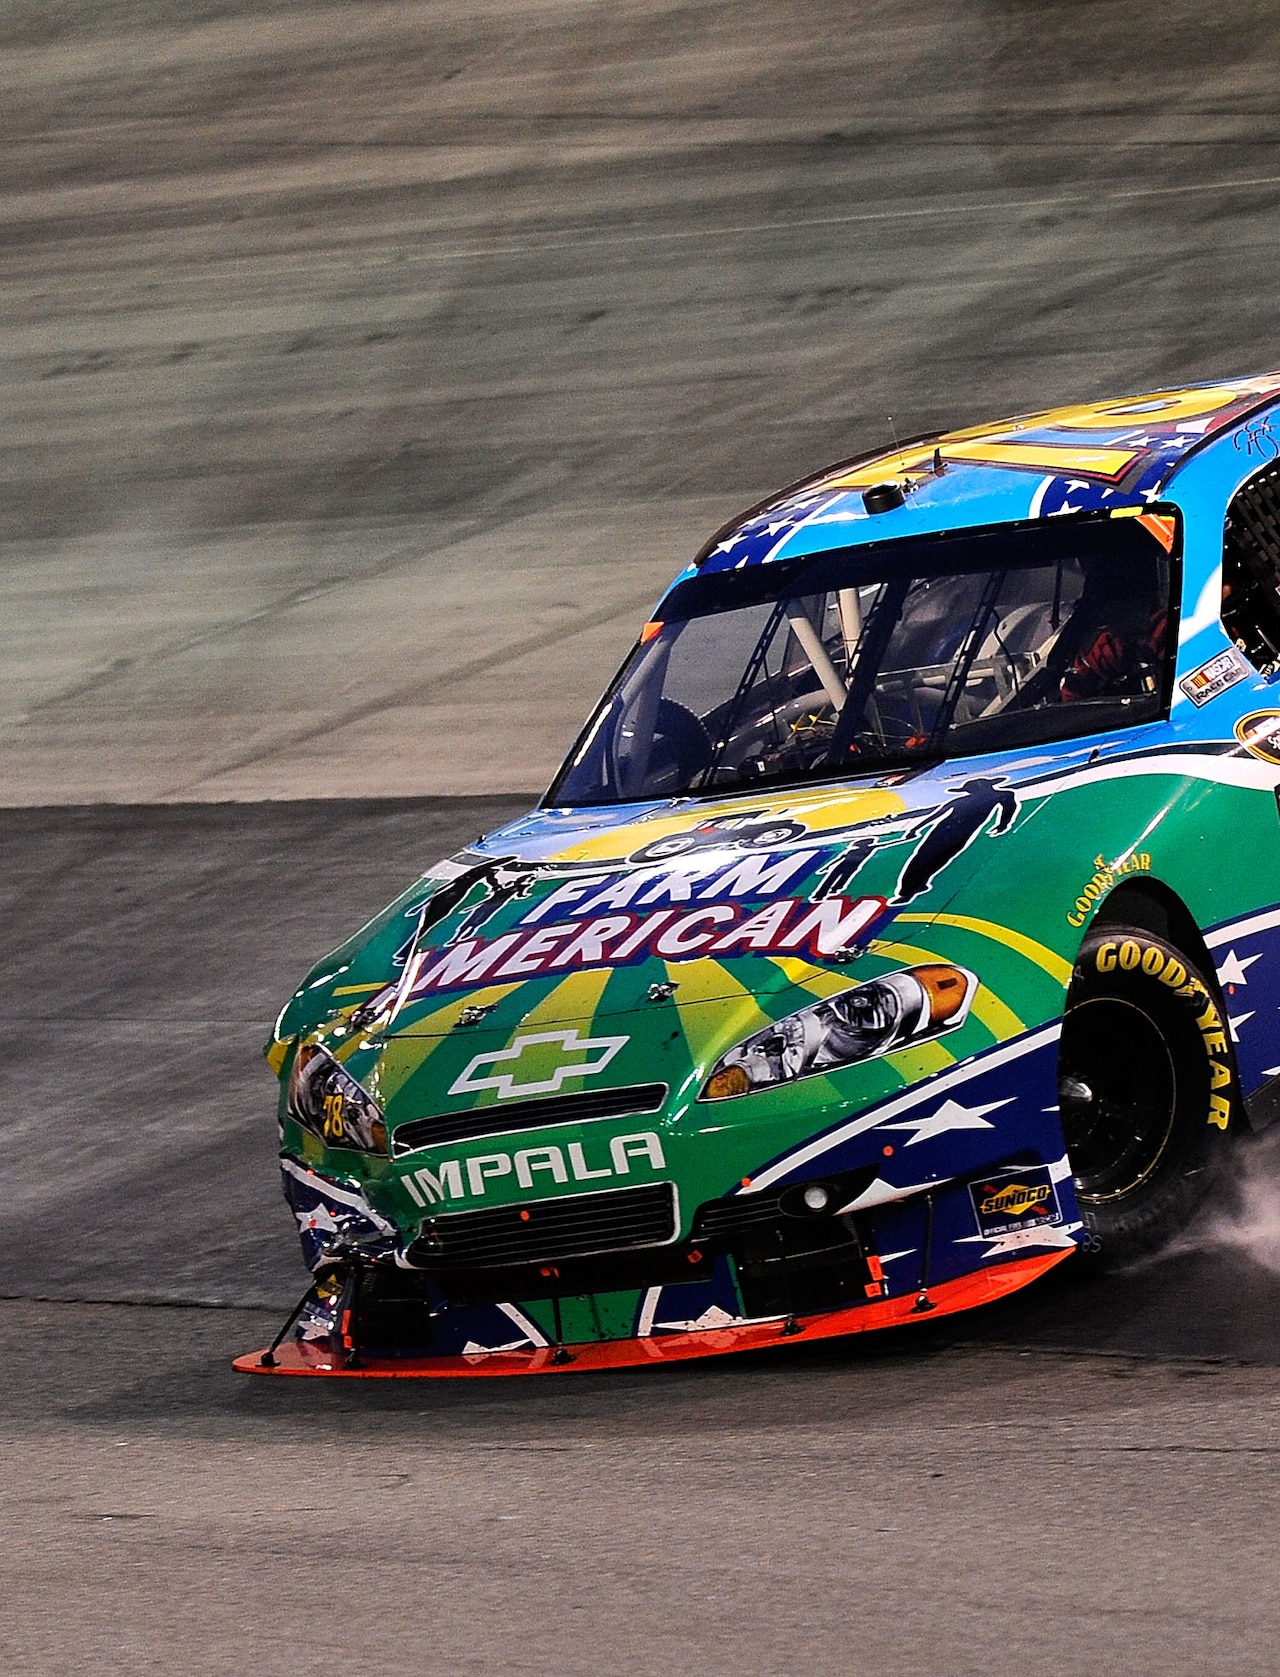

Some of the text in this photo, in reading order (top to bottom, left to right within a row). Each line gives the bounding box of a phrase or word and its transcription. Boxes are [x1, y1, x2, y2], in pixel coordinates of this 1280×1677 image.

[1205, 655, 1236, 681] NASCAR
[523, 849, 819, 924] FARM
[1067, 852, 1151, 927] GOODYEAR
[1096, 940, 1231, 1131] GOODYEAR
[323, 1095, 344, 1137] 78
[400, 1131, 666, 1208] IMPALA
[983, 1186, 1049, 1213] SUNOCO
